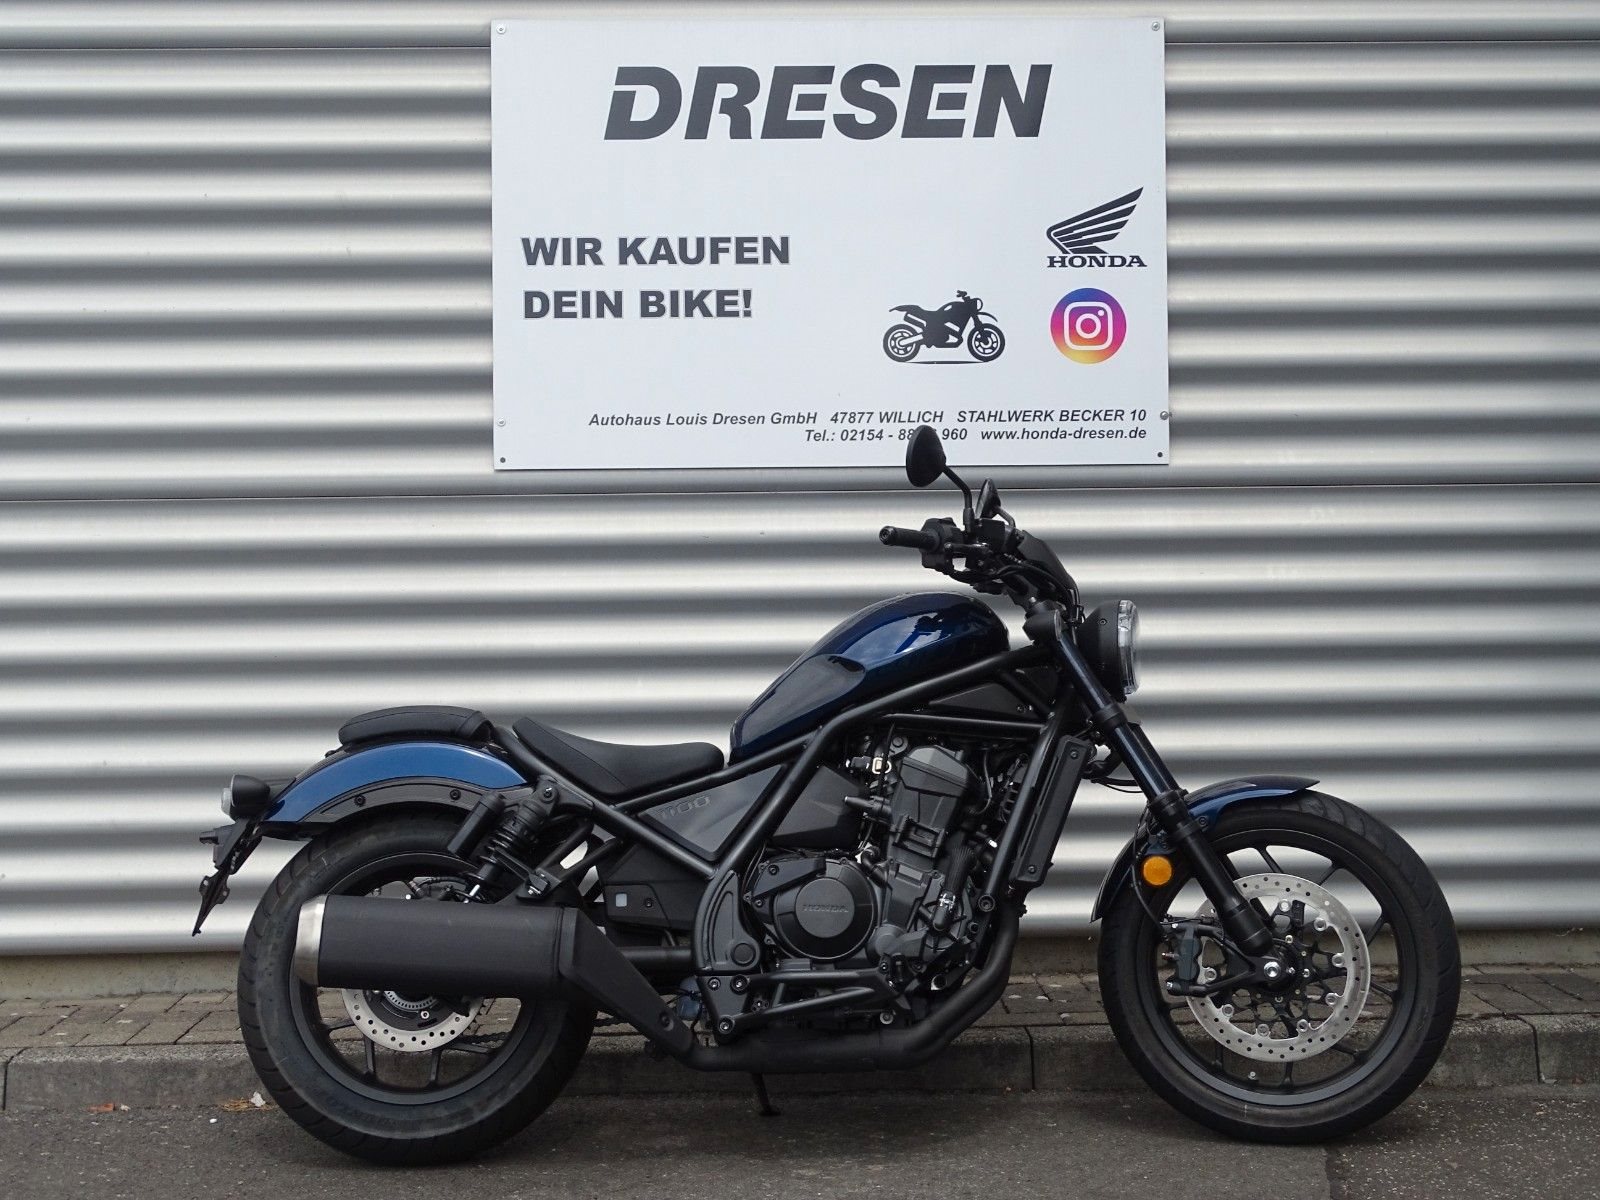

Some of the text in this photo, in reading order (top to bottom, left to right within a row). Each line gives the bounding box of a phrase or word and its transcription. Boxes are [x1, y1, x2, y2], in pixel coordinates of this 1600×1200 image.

[604, 64, 1053, 141] DRESEN
[521, 236, 790, 266] WIR KAUFEN
[1046, 255, 1148, 268] HONDA
[524, 289, 753, 319] DEIN BIKE!
[588, 409, 1147, 426] Autohaus Louis Dresen GmbH 47877 WILLICH STAHLWERK BECKER 10
[805, 429, 836, 442] Tel.:
[840, 429, 884, 441] 02154
[941, 427, 968, 440] 960
[980, 426, 1147, 440] www.honda-dresen.de
